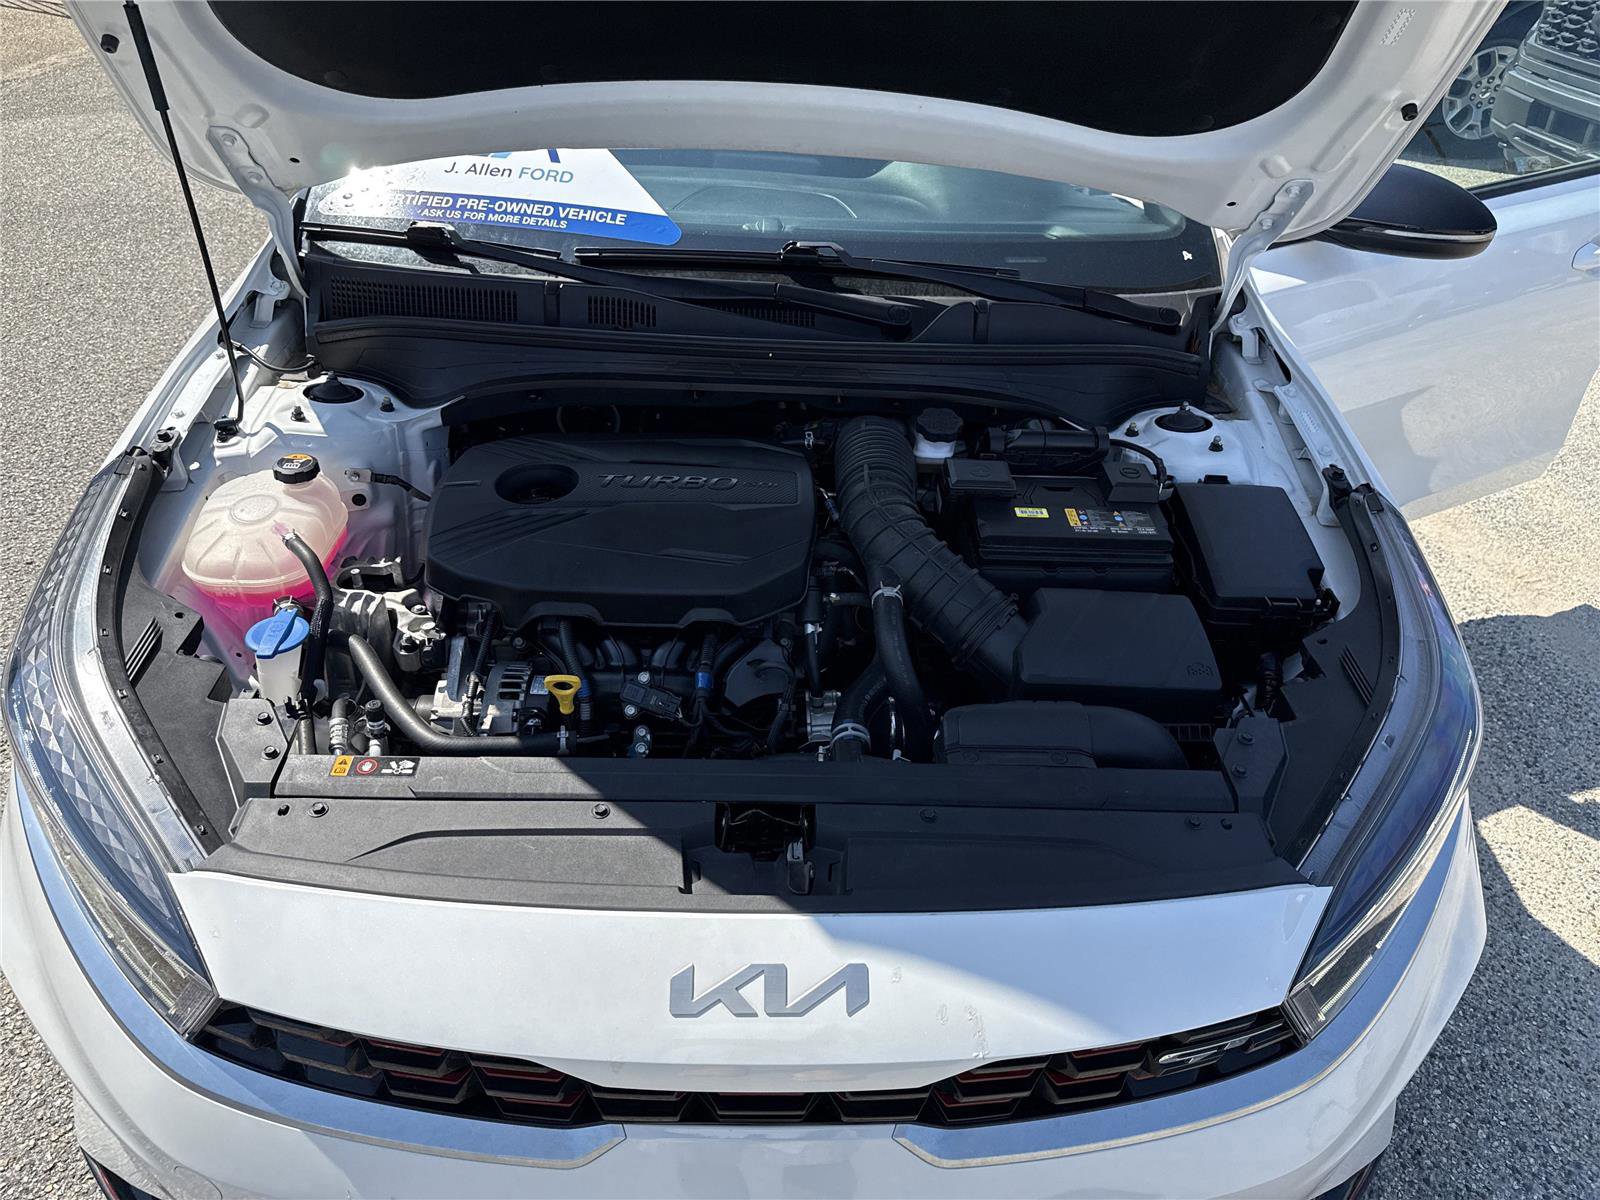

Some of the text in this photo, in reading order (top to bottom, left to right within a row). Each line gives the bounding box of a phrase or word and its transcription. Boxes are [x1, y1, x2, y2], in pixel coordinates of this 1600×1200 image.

[444, 161, 574, 183] J. Allen FORD
[420, 208, 568, 229] ASK US FOR MORE DETAILS
[456, 197, 554, 216] PRE-OWNED
[558, 206, 627, 225] VEHICLE
[598, 474, 738, 491] TURBO
[669, 962, 870, 1018] KIA
